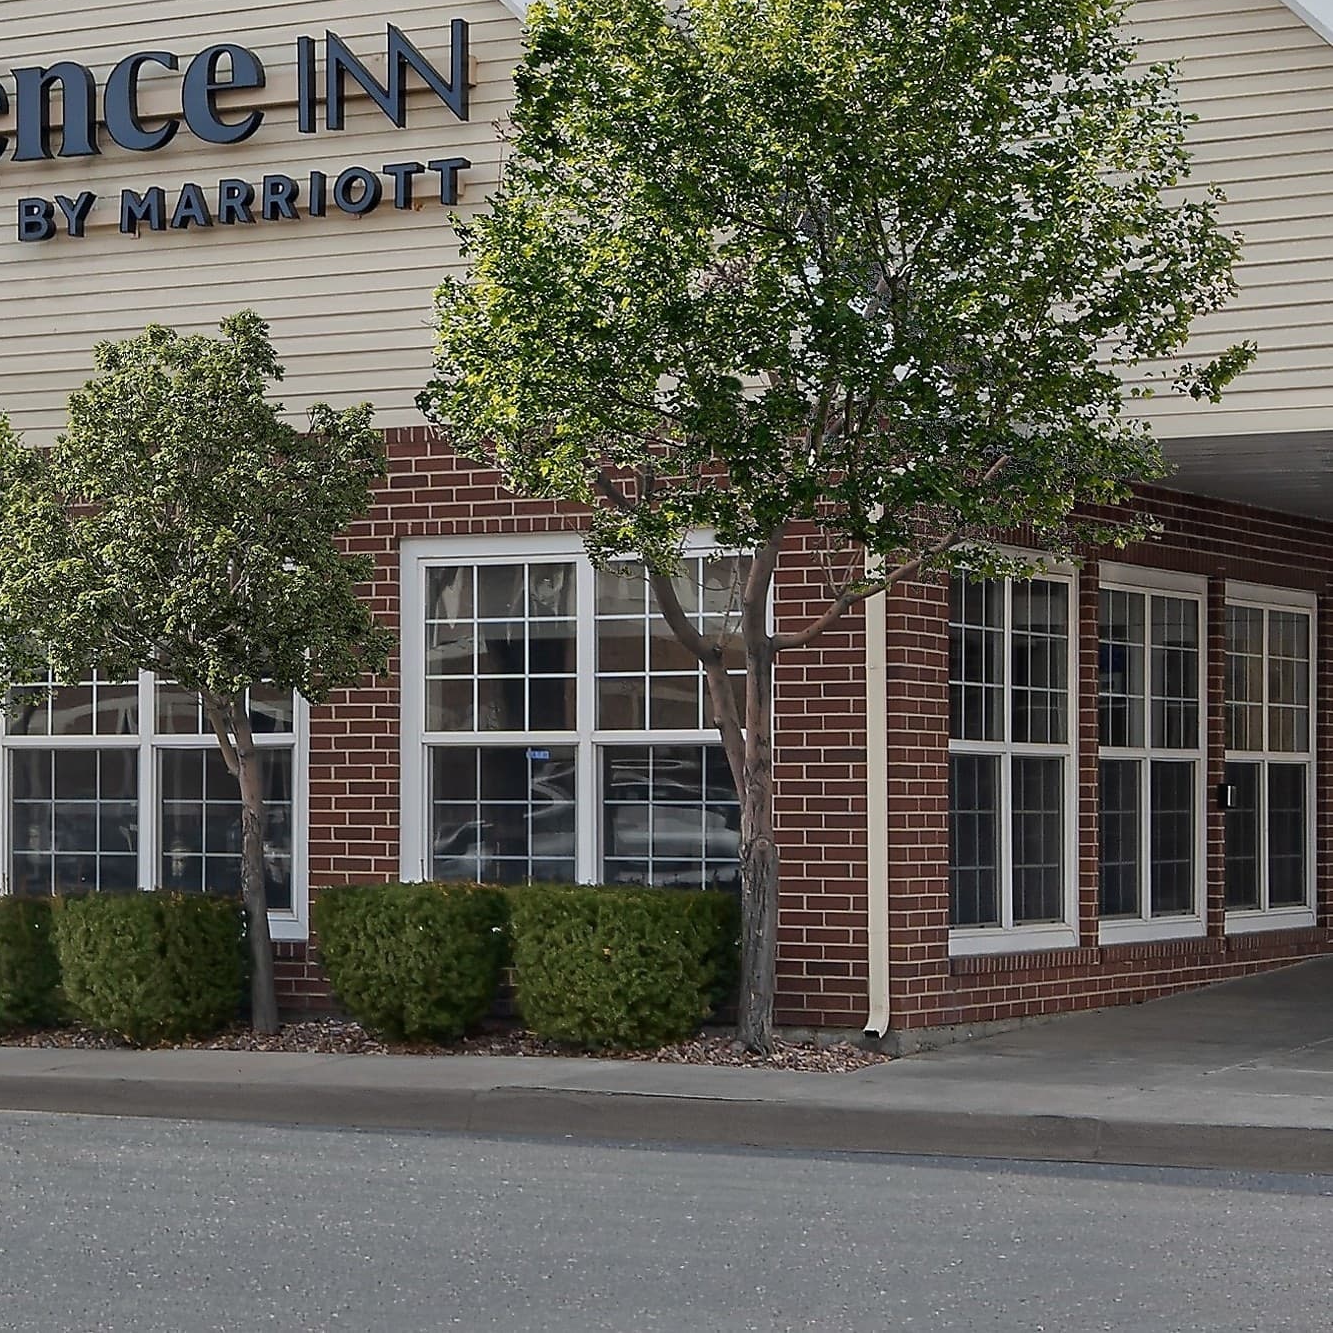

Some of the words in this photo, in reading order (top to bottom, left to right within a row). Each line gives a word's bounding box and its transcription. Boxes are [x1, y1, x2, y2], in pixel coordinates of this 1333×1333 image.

[297, 18, 470, 133] INN
[17, 191, 98, 242] BY
[119, 157, 472, 234] MARRIOTT
